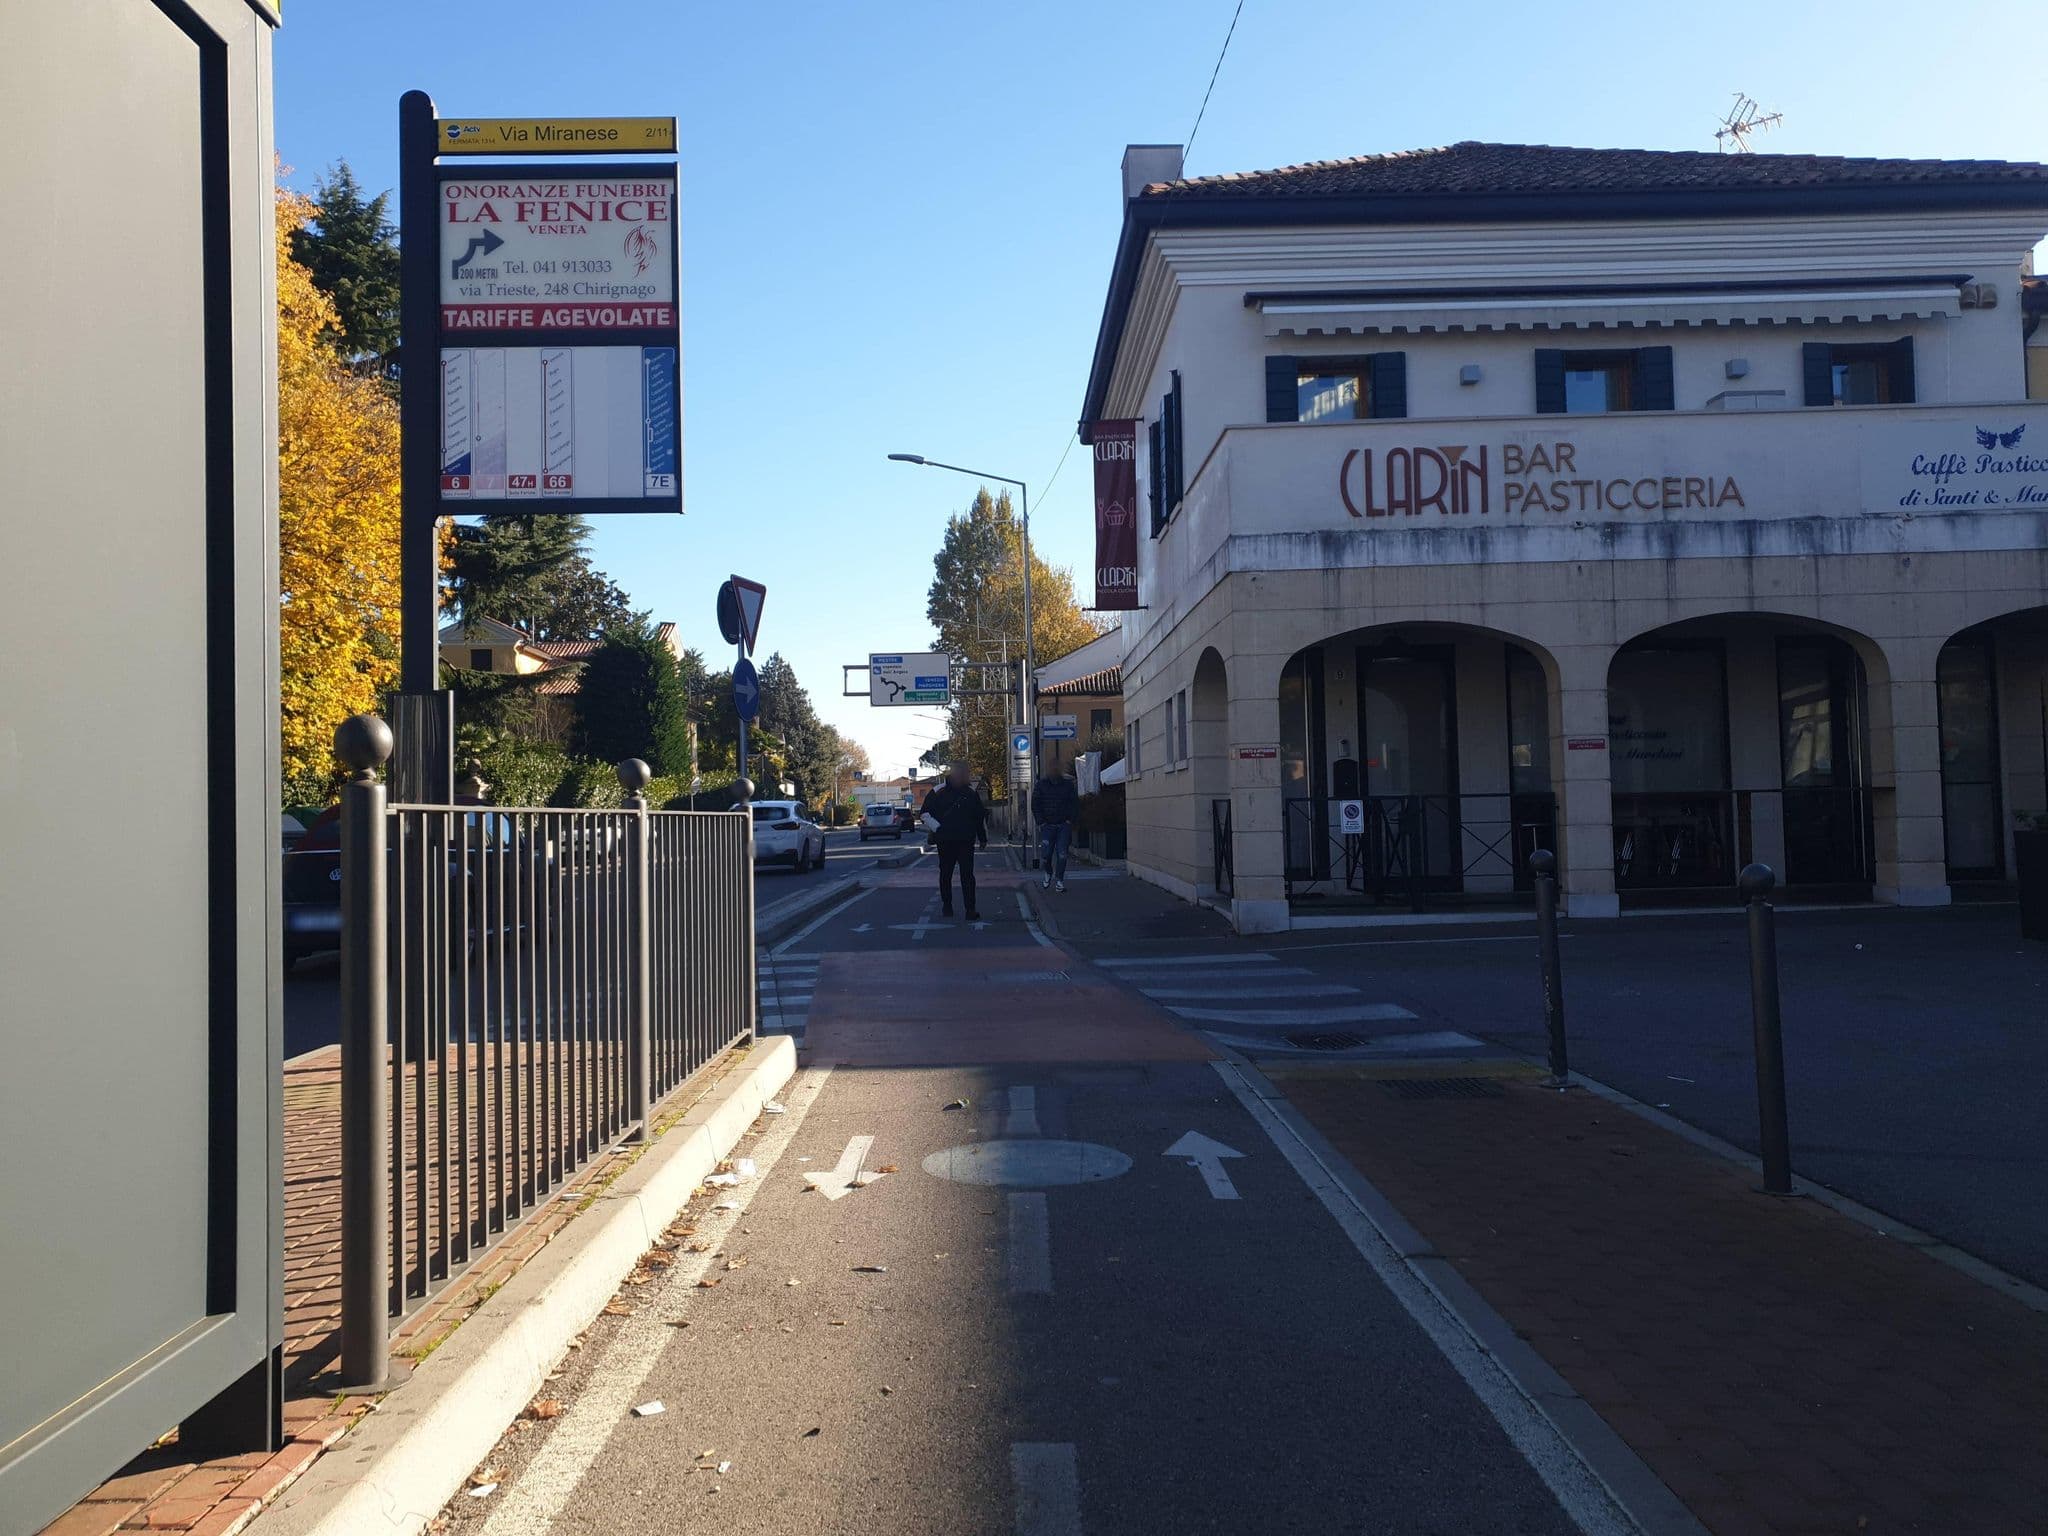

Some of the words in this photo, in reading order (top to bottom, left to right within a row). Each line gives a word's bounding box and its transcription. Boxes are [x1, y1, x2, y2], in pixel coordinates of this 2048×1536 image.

[499, 126, 528, 141] Via
[535, 125, 618, 141] Miranese
[645, 127, 668, 138] 2/11
[445, 185, 569, 199] ONORANZE
[575, 184, 667, 198] FUNEBRI
[447, 201, 503, 223] LA
[514, 200, 668, 222] FENICE
[528, 224, 587, 234] VENETA
[460, 268, 474, 279] 200
[475, 267, 498, 279] METRI
[503, 261, 528, 274] Tel.
[533, 261, 556, 274] 041
[562, 260, 612, 274] 913033
[459, 286, 481, 297] via
[487, 284, 540, 298] Trieste,
[544, 283, 569, 296] 248
[573, 282, 656, 299] Chirignago
[444, 309, 534, 328] TARIFFE
[540, 308, 670, 326] AGEVOLATE
[1503, 443, 1577, 475] BAR
[1911, 454, 1968, 484] Caffè
[451, 477, 460, 489] 6
[511, 476, 534, 489] 47H
[549, 475, 567, 489] 66
[651, 476, 669, 487] 7E
[1503, 476, 1745, 513] PASTICCERIA
[1900, 489, 1921, 506] di
[1924, 487, 1979, 505] Santi
[1983, 490, 1999, 504] &
